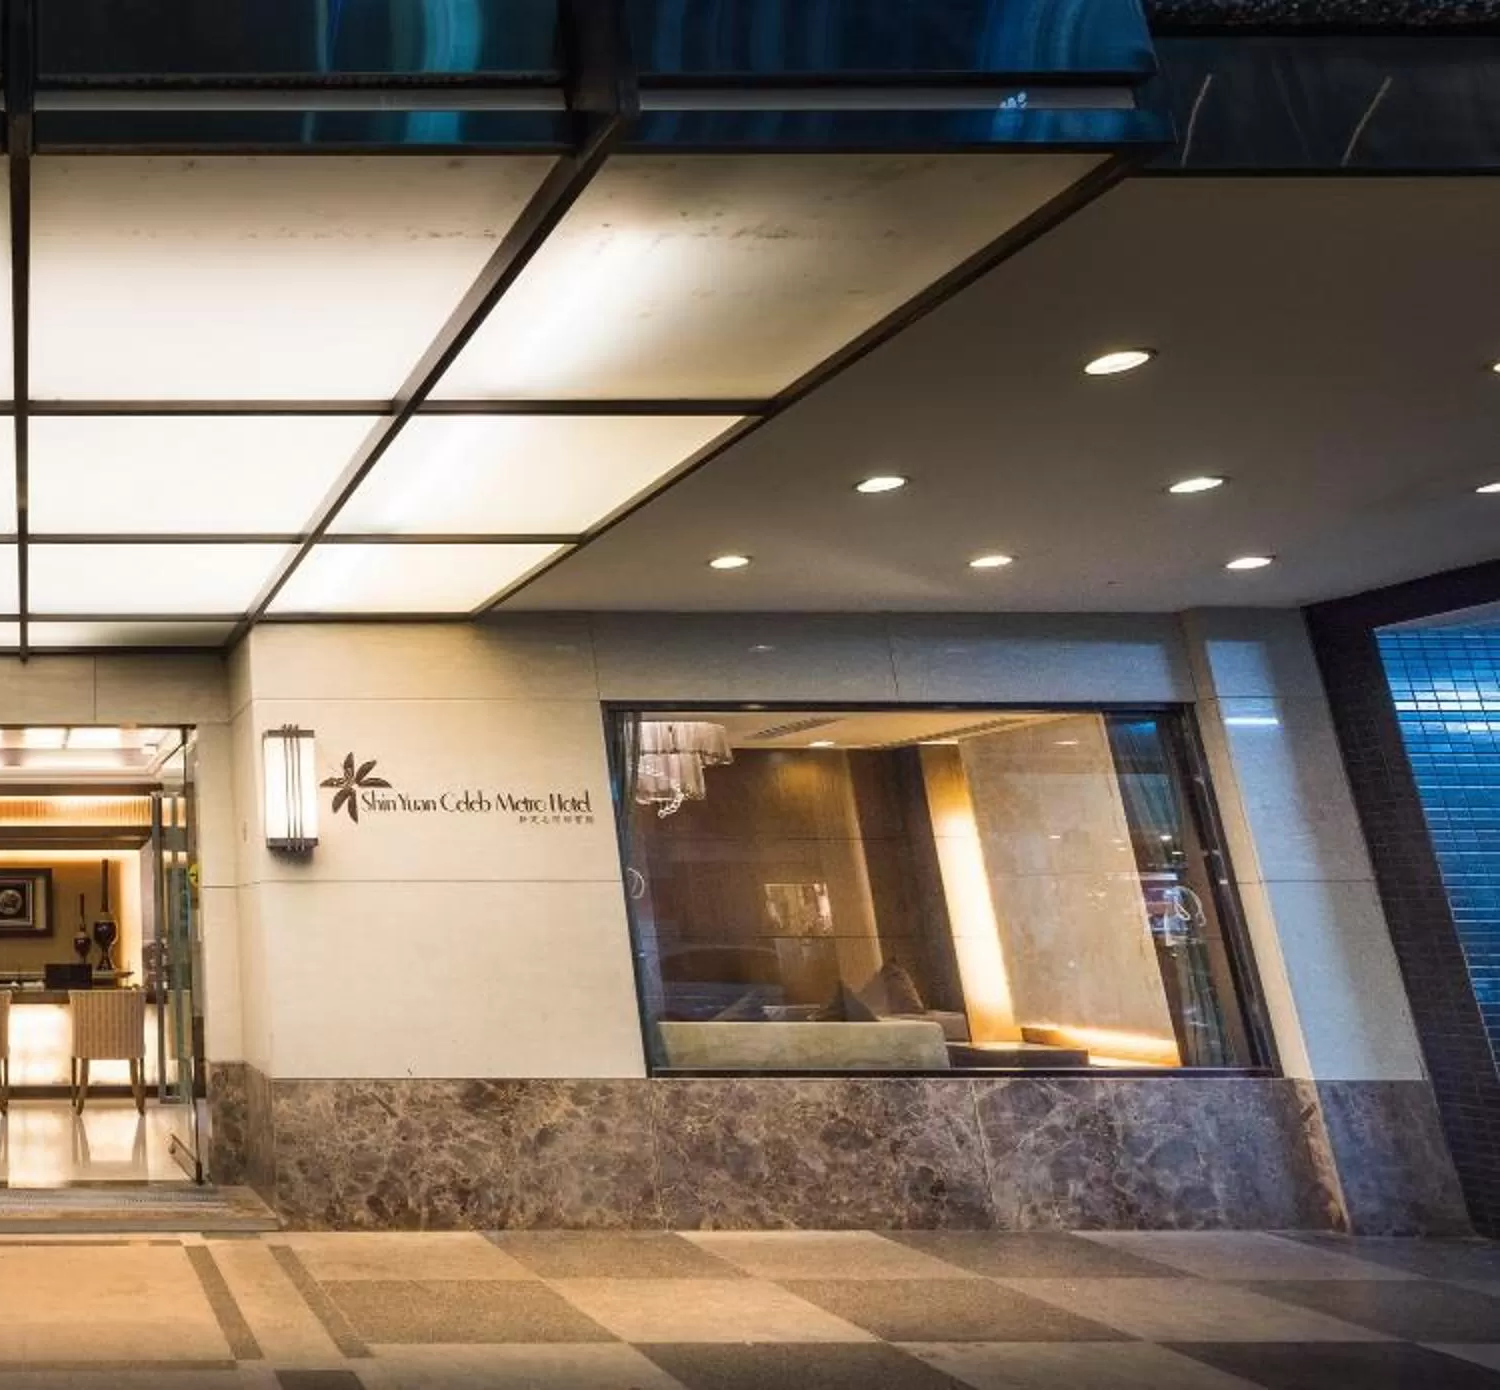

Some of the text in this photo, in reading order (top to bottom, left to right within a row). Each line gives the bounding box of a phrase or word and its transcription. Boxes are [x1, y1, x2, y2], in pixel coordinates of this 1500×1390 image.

[440, 789, 492, 813] Celeb
[496, 793, 548, 813] Metro
[549, 789, 592, 813] Hotel
